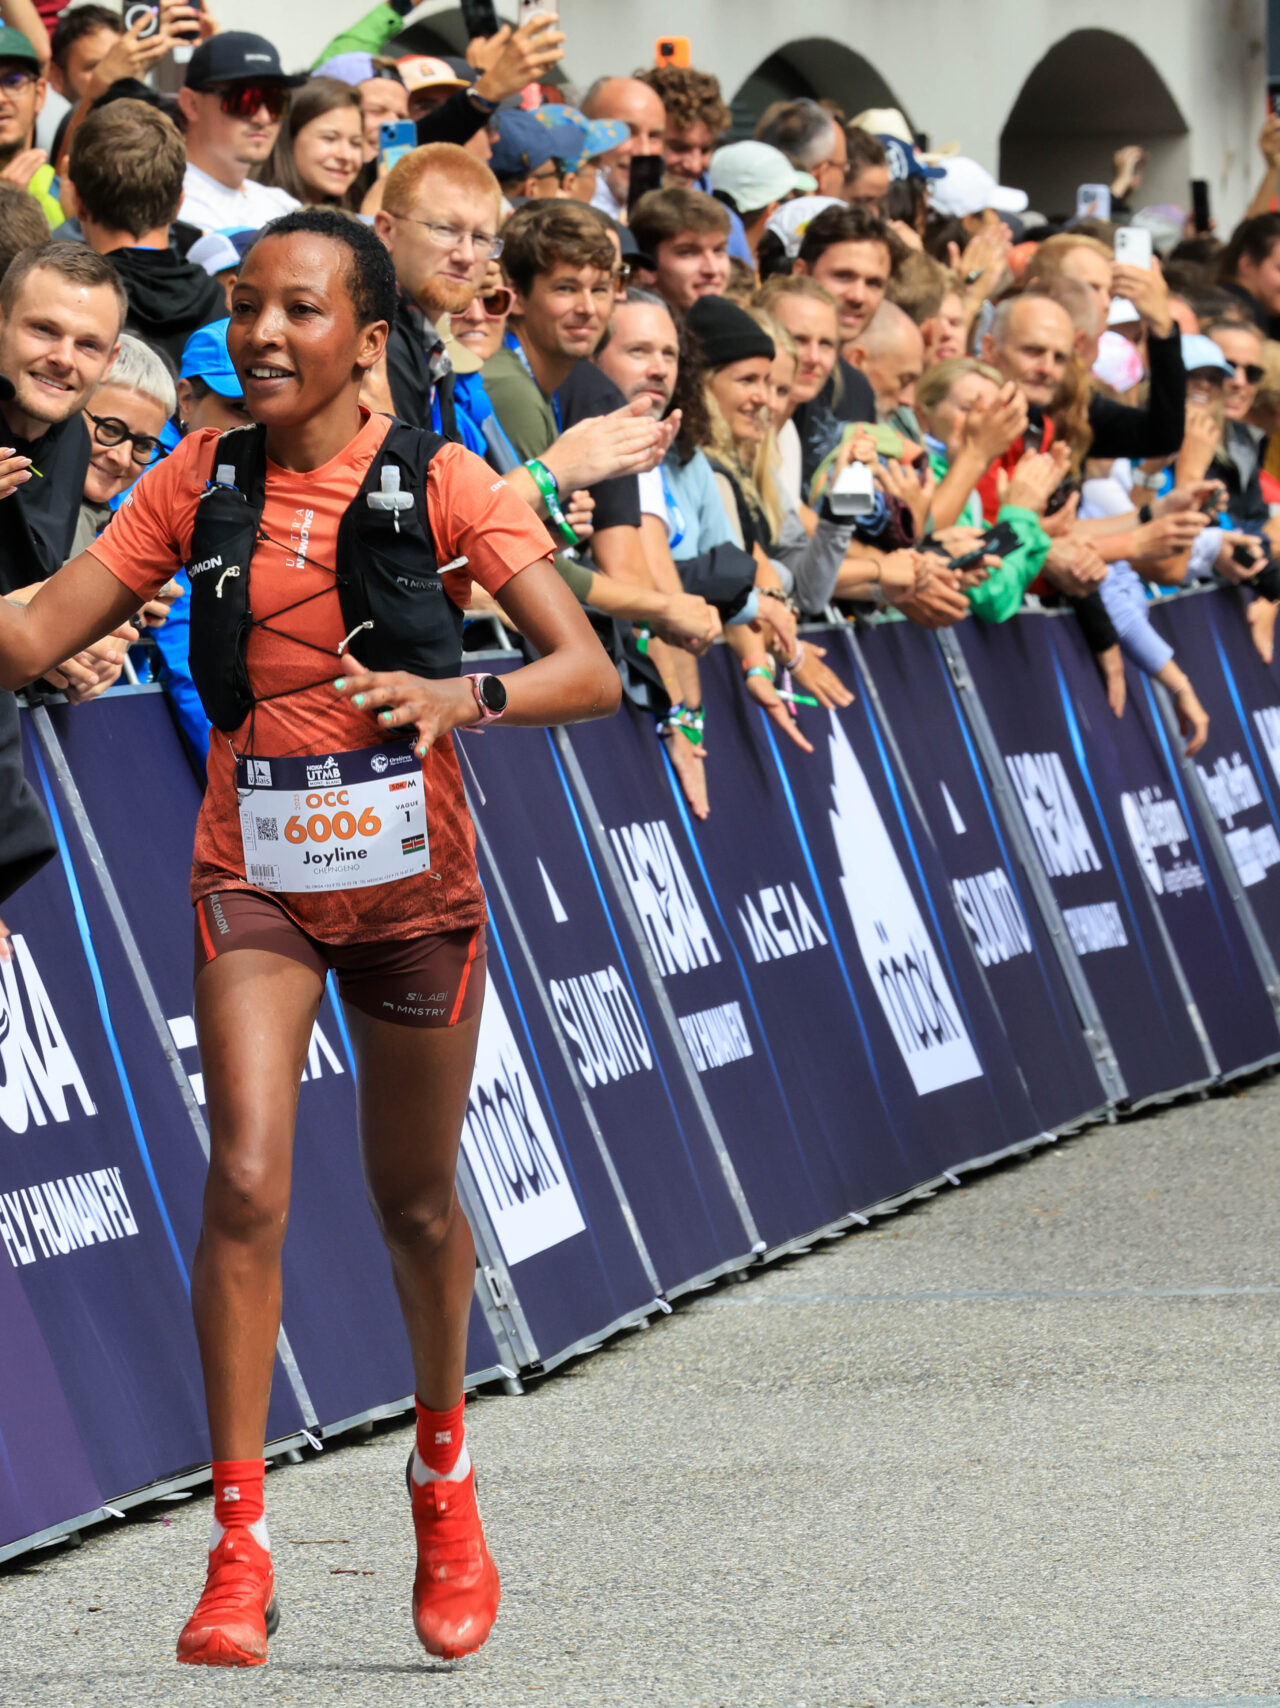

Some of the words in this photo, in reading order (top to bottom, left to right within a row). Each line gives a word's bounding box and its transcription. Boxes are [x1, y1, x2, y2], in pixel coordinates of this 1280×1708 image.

[296, 508, 315, 570] SALOMON
[249, 776, 271, 785] Vlais
[307, 768, 341, 780] UTMB
[407, 780, 417, 788] M
[306, 790, 349, 809] OCC
[395, 800, 419, 810] VAGUE
[404, 811, 411, 822] 1
[1006, 752, 1103, 878] HOKA
[284, 807, 382, 844] 6006
[303, 847, 368, 867] Joyline
[610, 820, 722, 977] HOKA
[209, 893, 231, 936] ALOMON
[397, 1005, 446, 1017] MNSTRY
[550, 966, 653, 1088] SUUNTO
[20, 1172, 117, 1258] HUMAN
[91, 1167, 139, 1239] FLY
